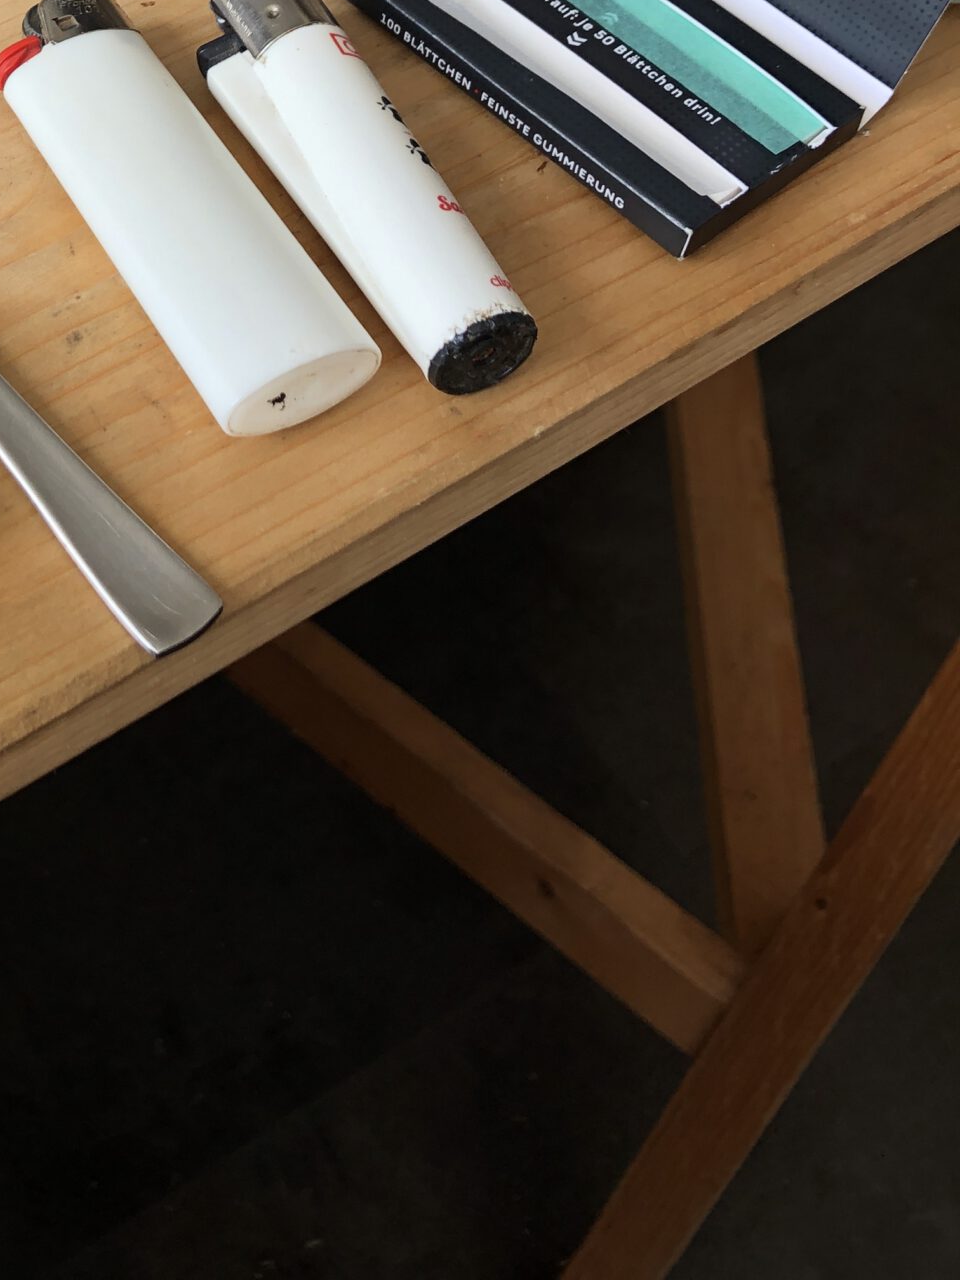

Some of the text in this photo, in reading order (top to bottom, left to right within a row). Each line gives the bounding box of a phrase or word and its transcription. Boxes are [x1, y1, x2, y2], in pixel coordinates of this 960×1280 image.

[380, 13, 626, 210] 100 BLÄTTCHEN FEINSTE GUMMIERUNG
[573, 17, 594, 32] je
[593, 30, 613, 47] 50
[613, 44, 684, 99] Blättchen
[683, 96, 723, 126] drin!
